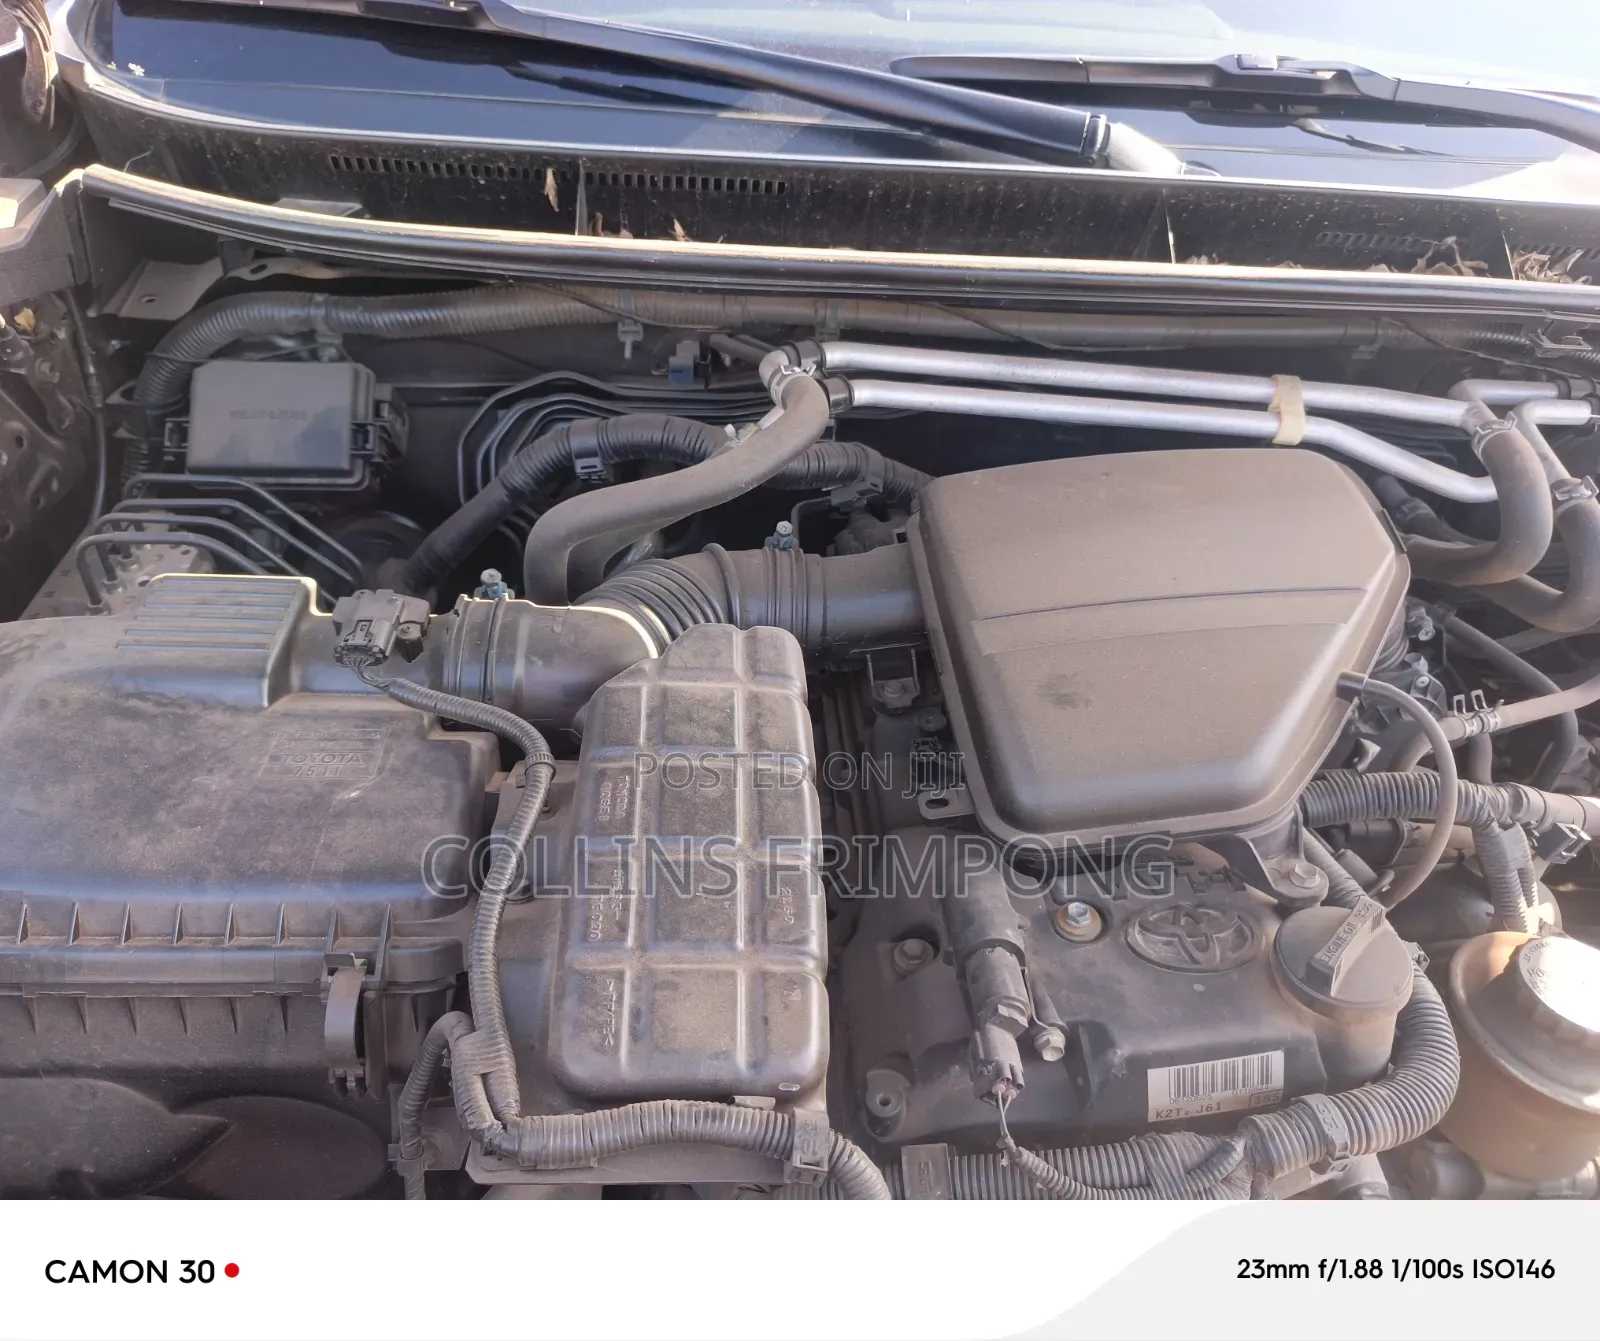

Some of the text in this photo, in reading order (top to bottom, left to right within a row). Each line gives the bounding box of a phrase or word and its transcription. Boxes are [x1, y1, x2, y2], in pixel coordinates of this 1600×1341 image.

[282, 753, 362, 764] TOYOTA
[1321, 920, 1359, 965] ENGINE OIL
